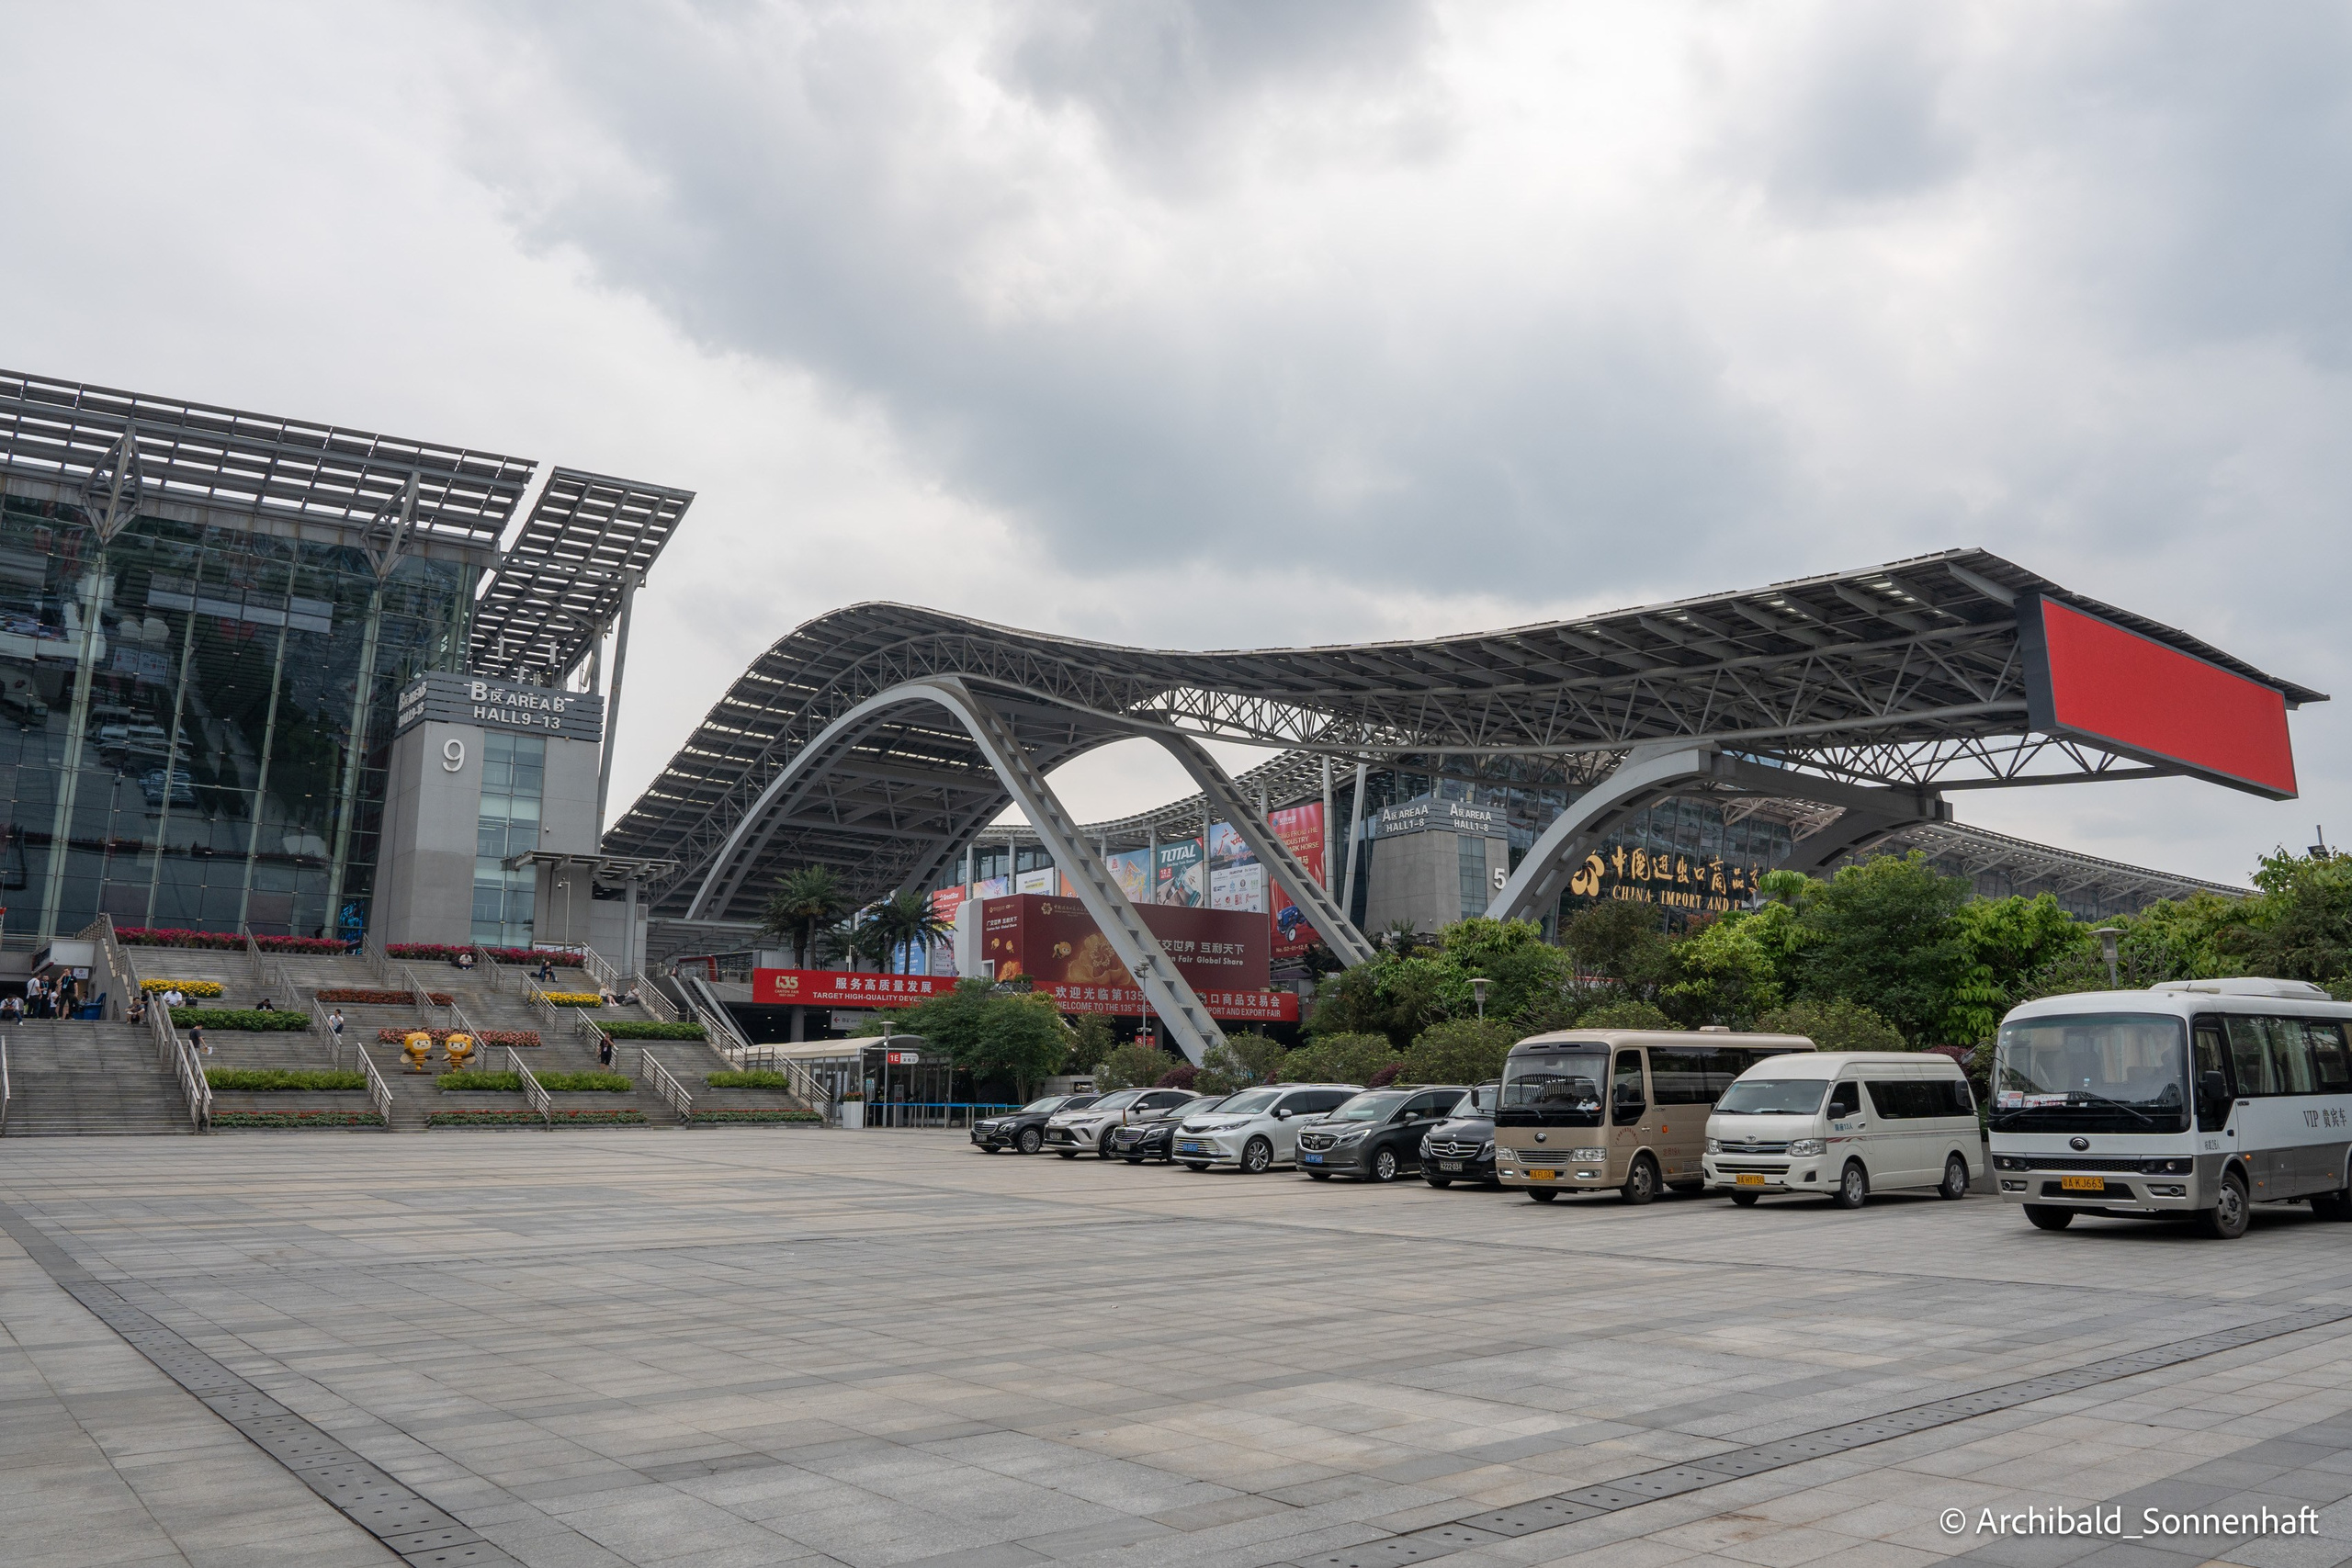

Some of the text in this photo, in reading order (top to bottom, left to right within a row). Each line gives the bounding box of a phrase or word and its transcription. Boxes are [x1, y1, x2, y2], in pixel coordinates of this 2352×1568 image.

[506, 694, 550, 711] AREA
[442, 739, 466, 773] 9
[1300, 841, 1319, 850] HORSE
[1494, 867, 1507, 890] 5
[1660, 890, 1702, 909] IMPORT
[1707, 897, 1729, 912] AND
[1200, 942, 1245, 955] 互利天下
[1196, 955, 1221, 964] Global
[1223, 957, 1244, 965] Share
[835, 976, 932, 993] 服务高质量发展
[813, 991, 843, 999] TARGET
[844, 993, 898, 1002] HIGH-QUALITY
[1055, 986, 1280, 1008] 欢迎光临第135 口商品交易会
[1093, 1002, 1103, 1010] TO
[1105, 1003, 1118, 1011] THE
[1206, 1007, 1226, 1015] PORT
[1241, 1009, 1265, 1017] EXPORT
[2303, 1107, 2347, 1129] VIP 贵宾车
